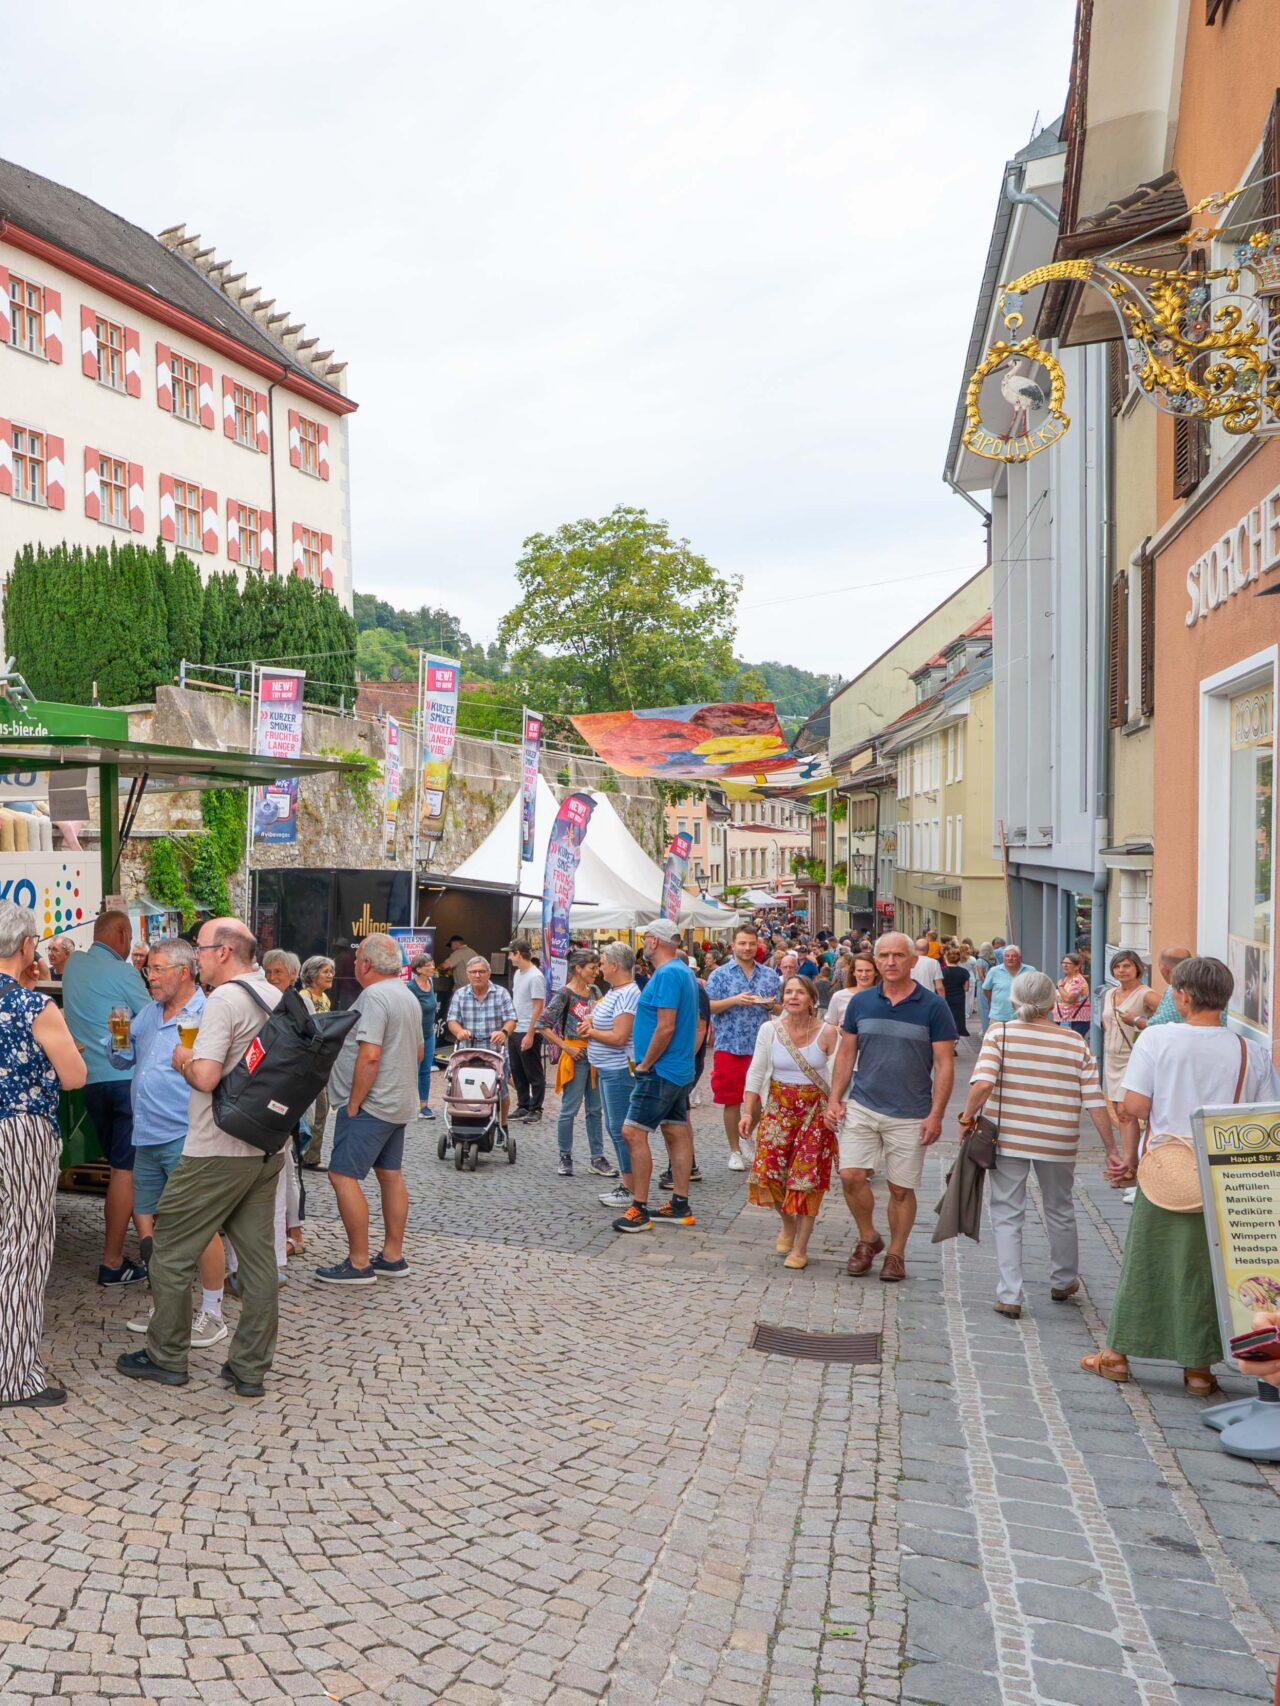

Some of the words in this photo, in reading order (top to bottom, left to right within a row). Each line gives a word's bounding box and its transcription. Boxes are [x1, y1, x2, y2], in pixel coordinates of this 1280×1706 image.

[970, 418, 1061, 456] APOTHEKE
[435, 671, 452, 681] NEW!
[272, 682, 293, 691] NEW!
[269, 712, 296, 722] KURZER
[270, 722, 294, 732] SMOKE,
[265, 731, 299, 742] FRUCHTIG
[268, 741, 295, 752] LANGER
[569, 800, 586, 817] NEW!
[1230, 1155, 1257, 1164] Haupt
[1258, 1154, 1274, 1162] Str.
[1224, 1183, 1270, 1191] Auffüllen
[1226, 1195, 1273, 1203] Maniküre
[1229, 1220, 1275, 1228] Wimpern
[1231, 1232, 1277, 1241] Wimpern
[1233, 1245, 1278, 1253] Headspa
[1235, 1257, 1280, 1266] Headspa
